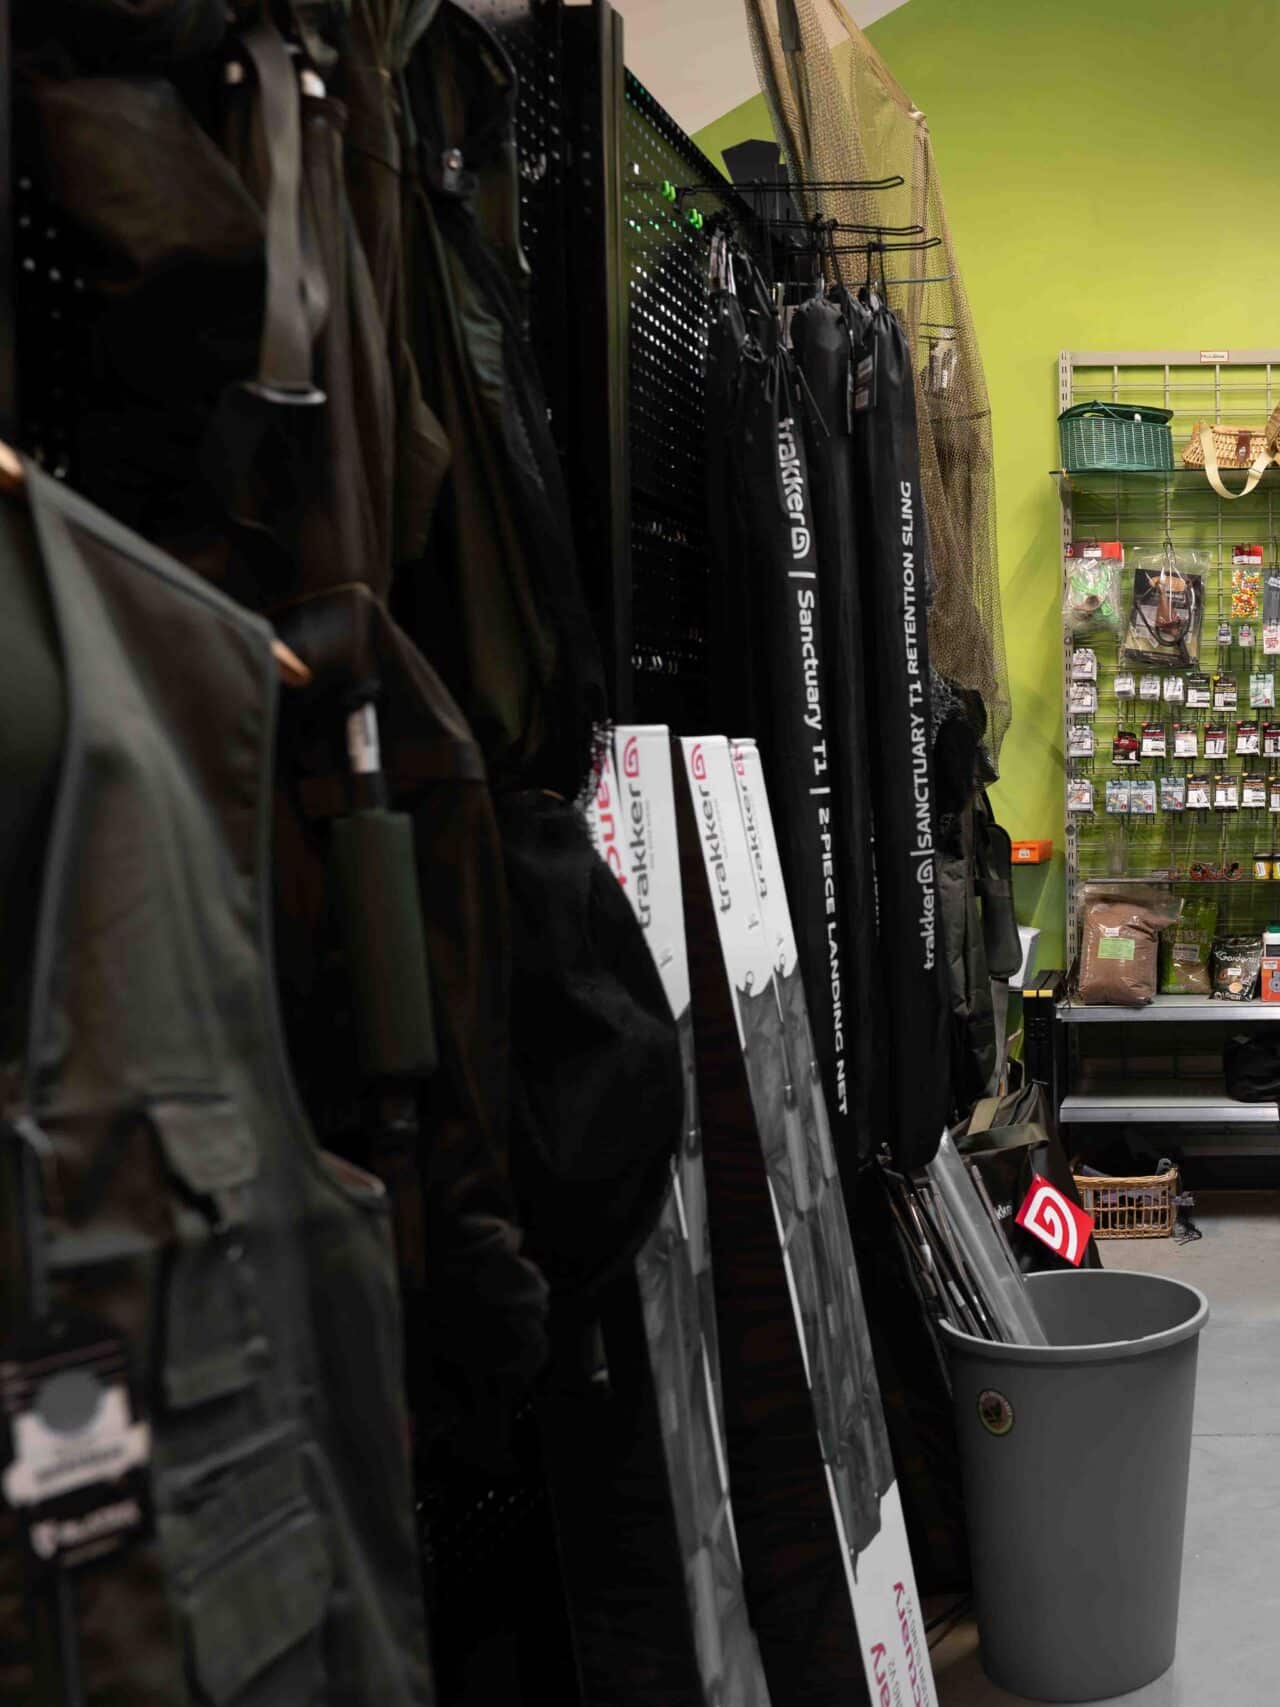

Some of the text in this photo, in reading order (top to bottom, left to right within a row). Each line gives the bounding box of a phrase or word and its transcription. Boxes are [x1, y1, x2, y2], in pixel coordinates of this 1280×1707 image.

[629, 783, 651, 929] trakker
[698, 784, 732, 914] trakker
[778, 417, 848, 1115] trakker Sanctuary T1 2-PIECE LANDING NET
[900, 480, 935, 970] trakker SANCTUARY T1 RETENTION SLING
